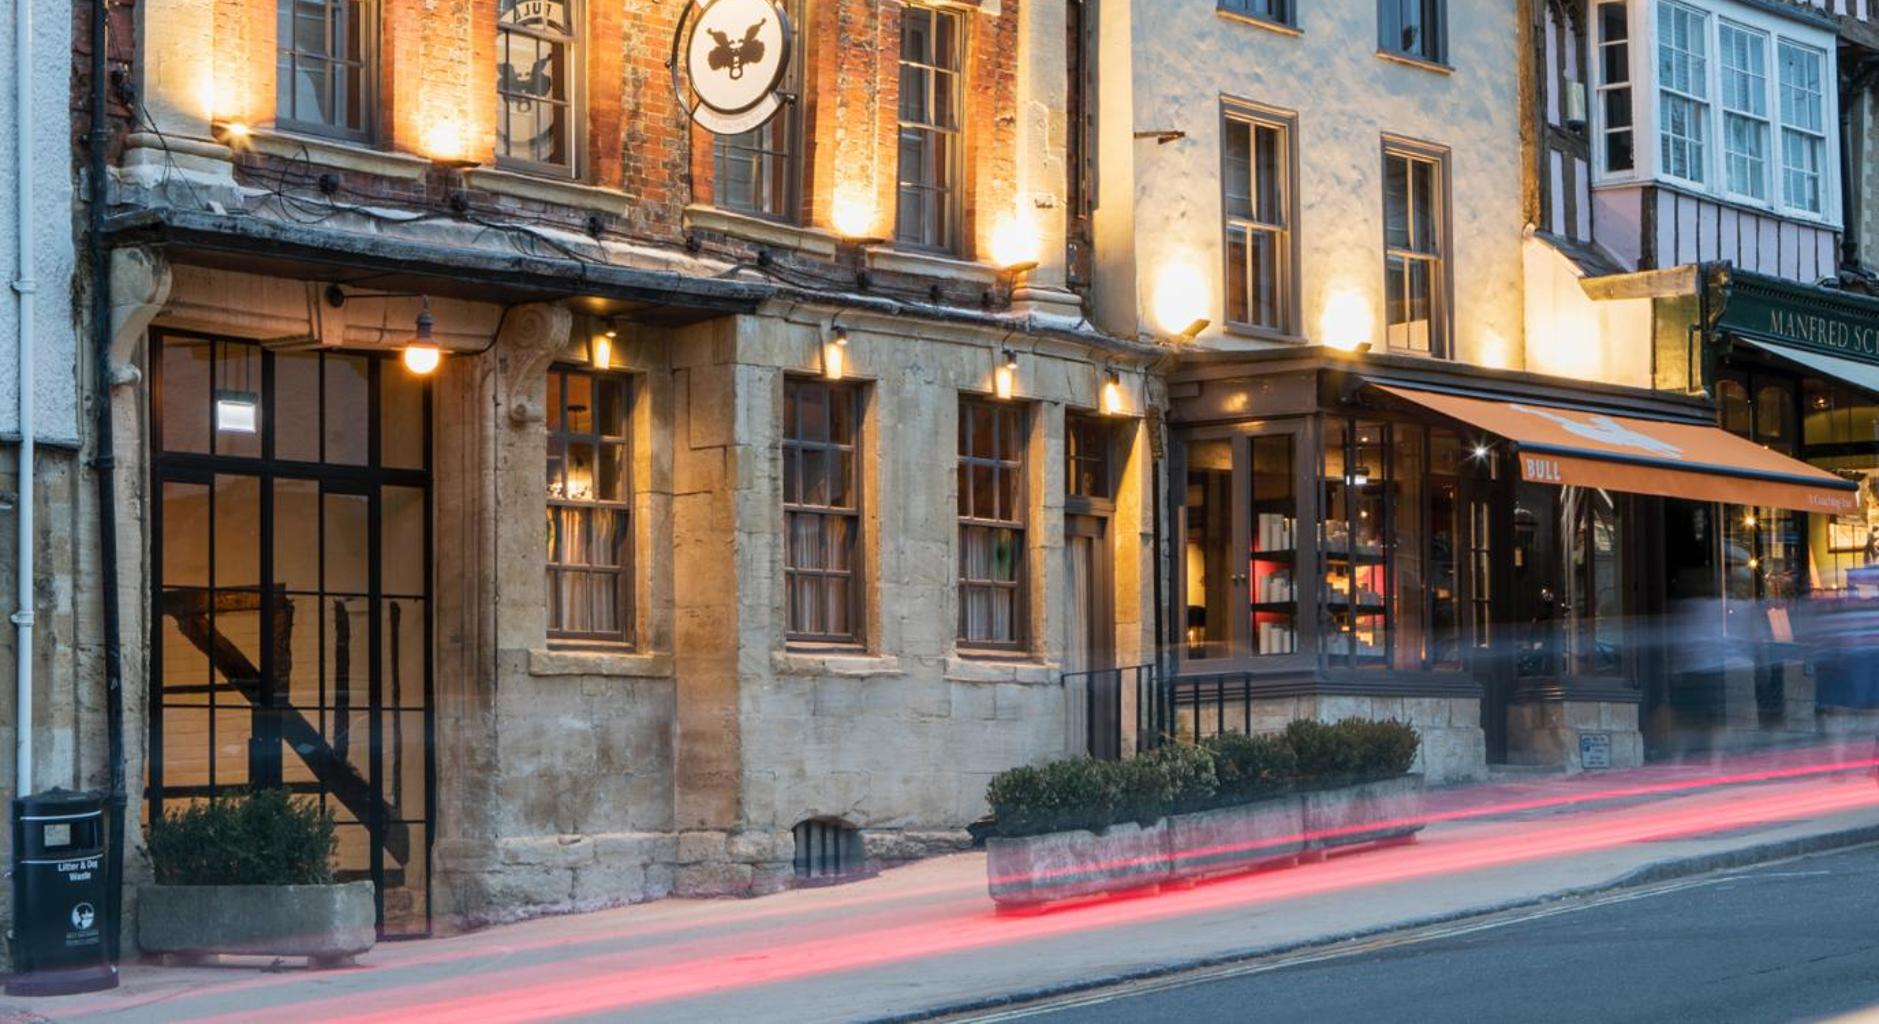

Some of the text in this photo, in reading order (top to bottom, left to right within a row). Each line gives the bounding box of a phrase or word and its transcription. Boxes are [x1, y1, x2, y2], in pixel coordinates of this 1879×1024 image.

[1770, 309, 1848, 348] MANFRED
[1526, 459, 1560, 481] BULL
[69, 871, 91, 882] Waste
